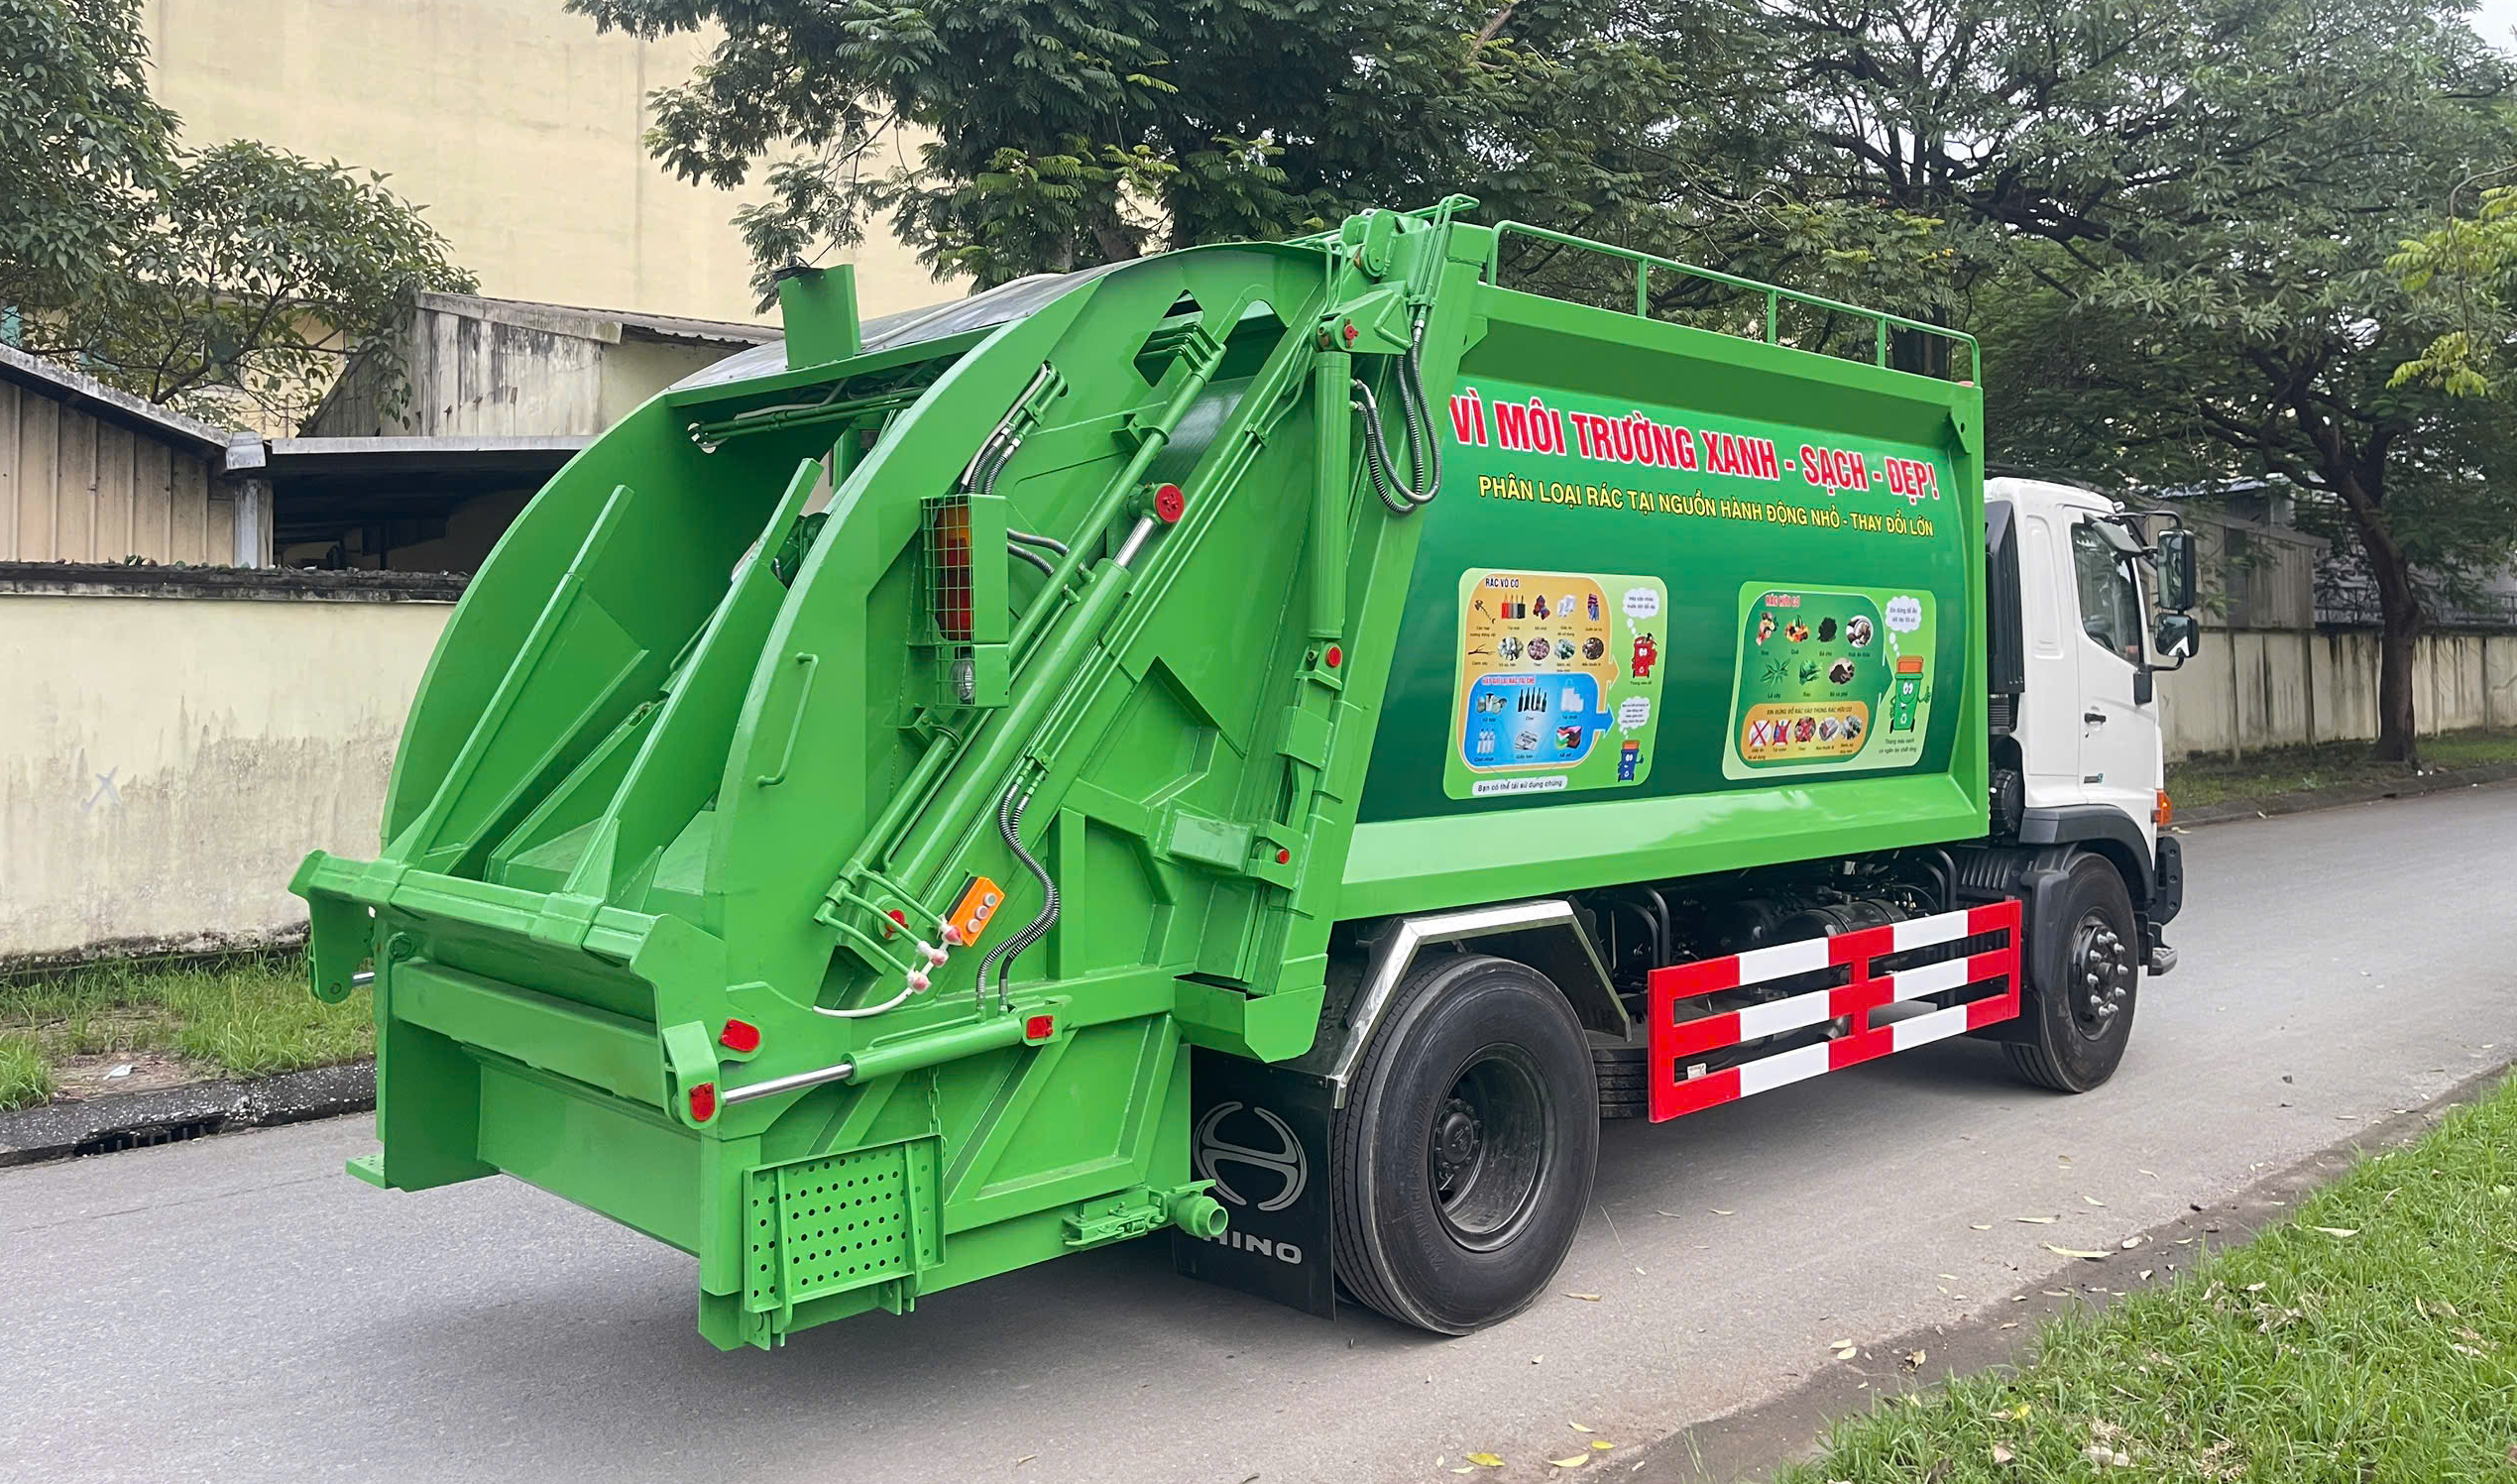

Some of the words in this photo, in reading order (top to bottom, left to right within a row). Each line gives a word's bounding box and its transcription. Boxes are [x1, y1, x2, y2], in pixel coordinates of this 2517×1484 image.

[1450, 388, 1487, 446] VÌ
[1493, 397, 1566, 455] MÔI
[1569, 410, 1698, 472] TRƯỜNG
[1699, 430, 1779, 481] XANH
[1800, 444, 1869, 496] SẠCH
[1884, 456, 1940, 505] ĐẸP!
[1478, 473, 1534, 501] PHÂN
[1539, 481, 1582, 509] LOẠI
[1586, 482, 1623, 510] RÁC
[1627, 490, 1655, 515] TẠI
[1659, 489, 1717, 516] NGUỒN
[1720, 497, 1763, 521] HÀNH
[1766, 502, 1807, 526] ĐỘNG
[1811, 504, 1840, 528] NHỎ
[1850, 513, 1883, 532] THAY
[1887, 509, 1907, 534] ĐỔI
[1910, 517, 1934, 537] LỚN
